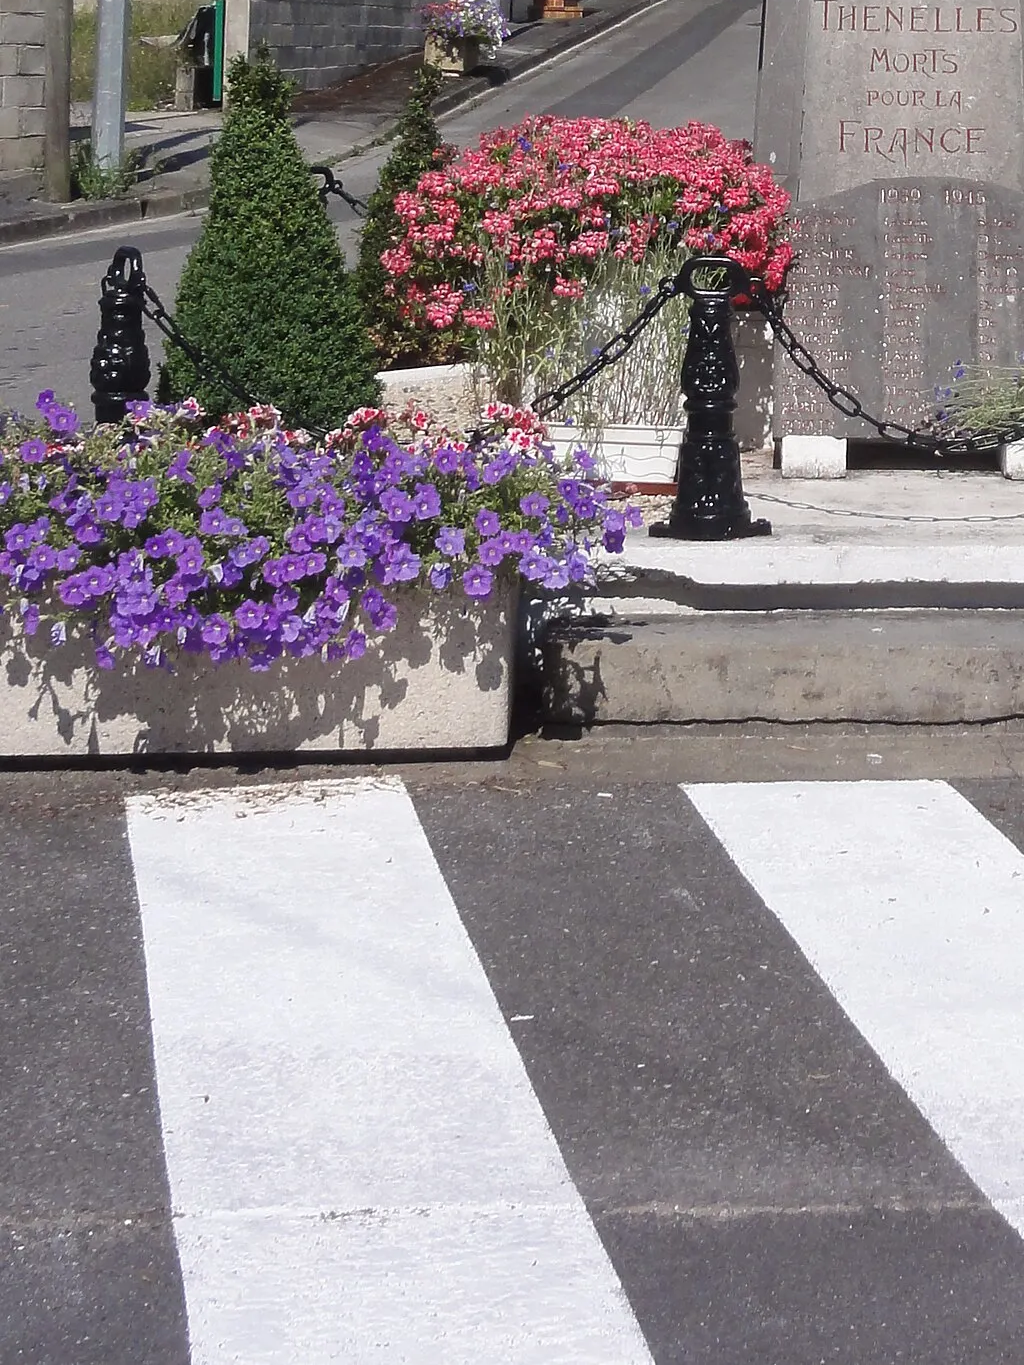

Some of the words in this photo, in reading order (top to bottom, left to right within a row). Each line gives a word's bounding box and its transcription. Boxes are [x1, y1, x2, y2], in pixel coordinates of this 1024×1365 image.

[869, 47, 959, 79] MORTS
[866, 90, 934, 109] POUR
[936, 90, 963, 114] LA
[838, 120, 988, 166] FRANCE
[881, 187, 921, 204] 1939
[945, 188, 986, 205] 1945
